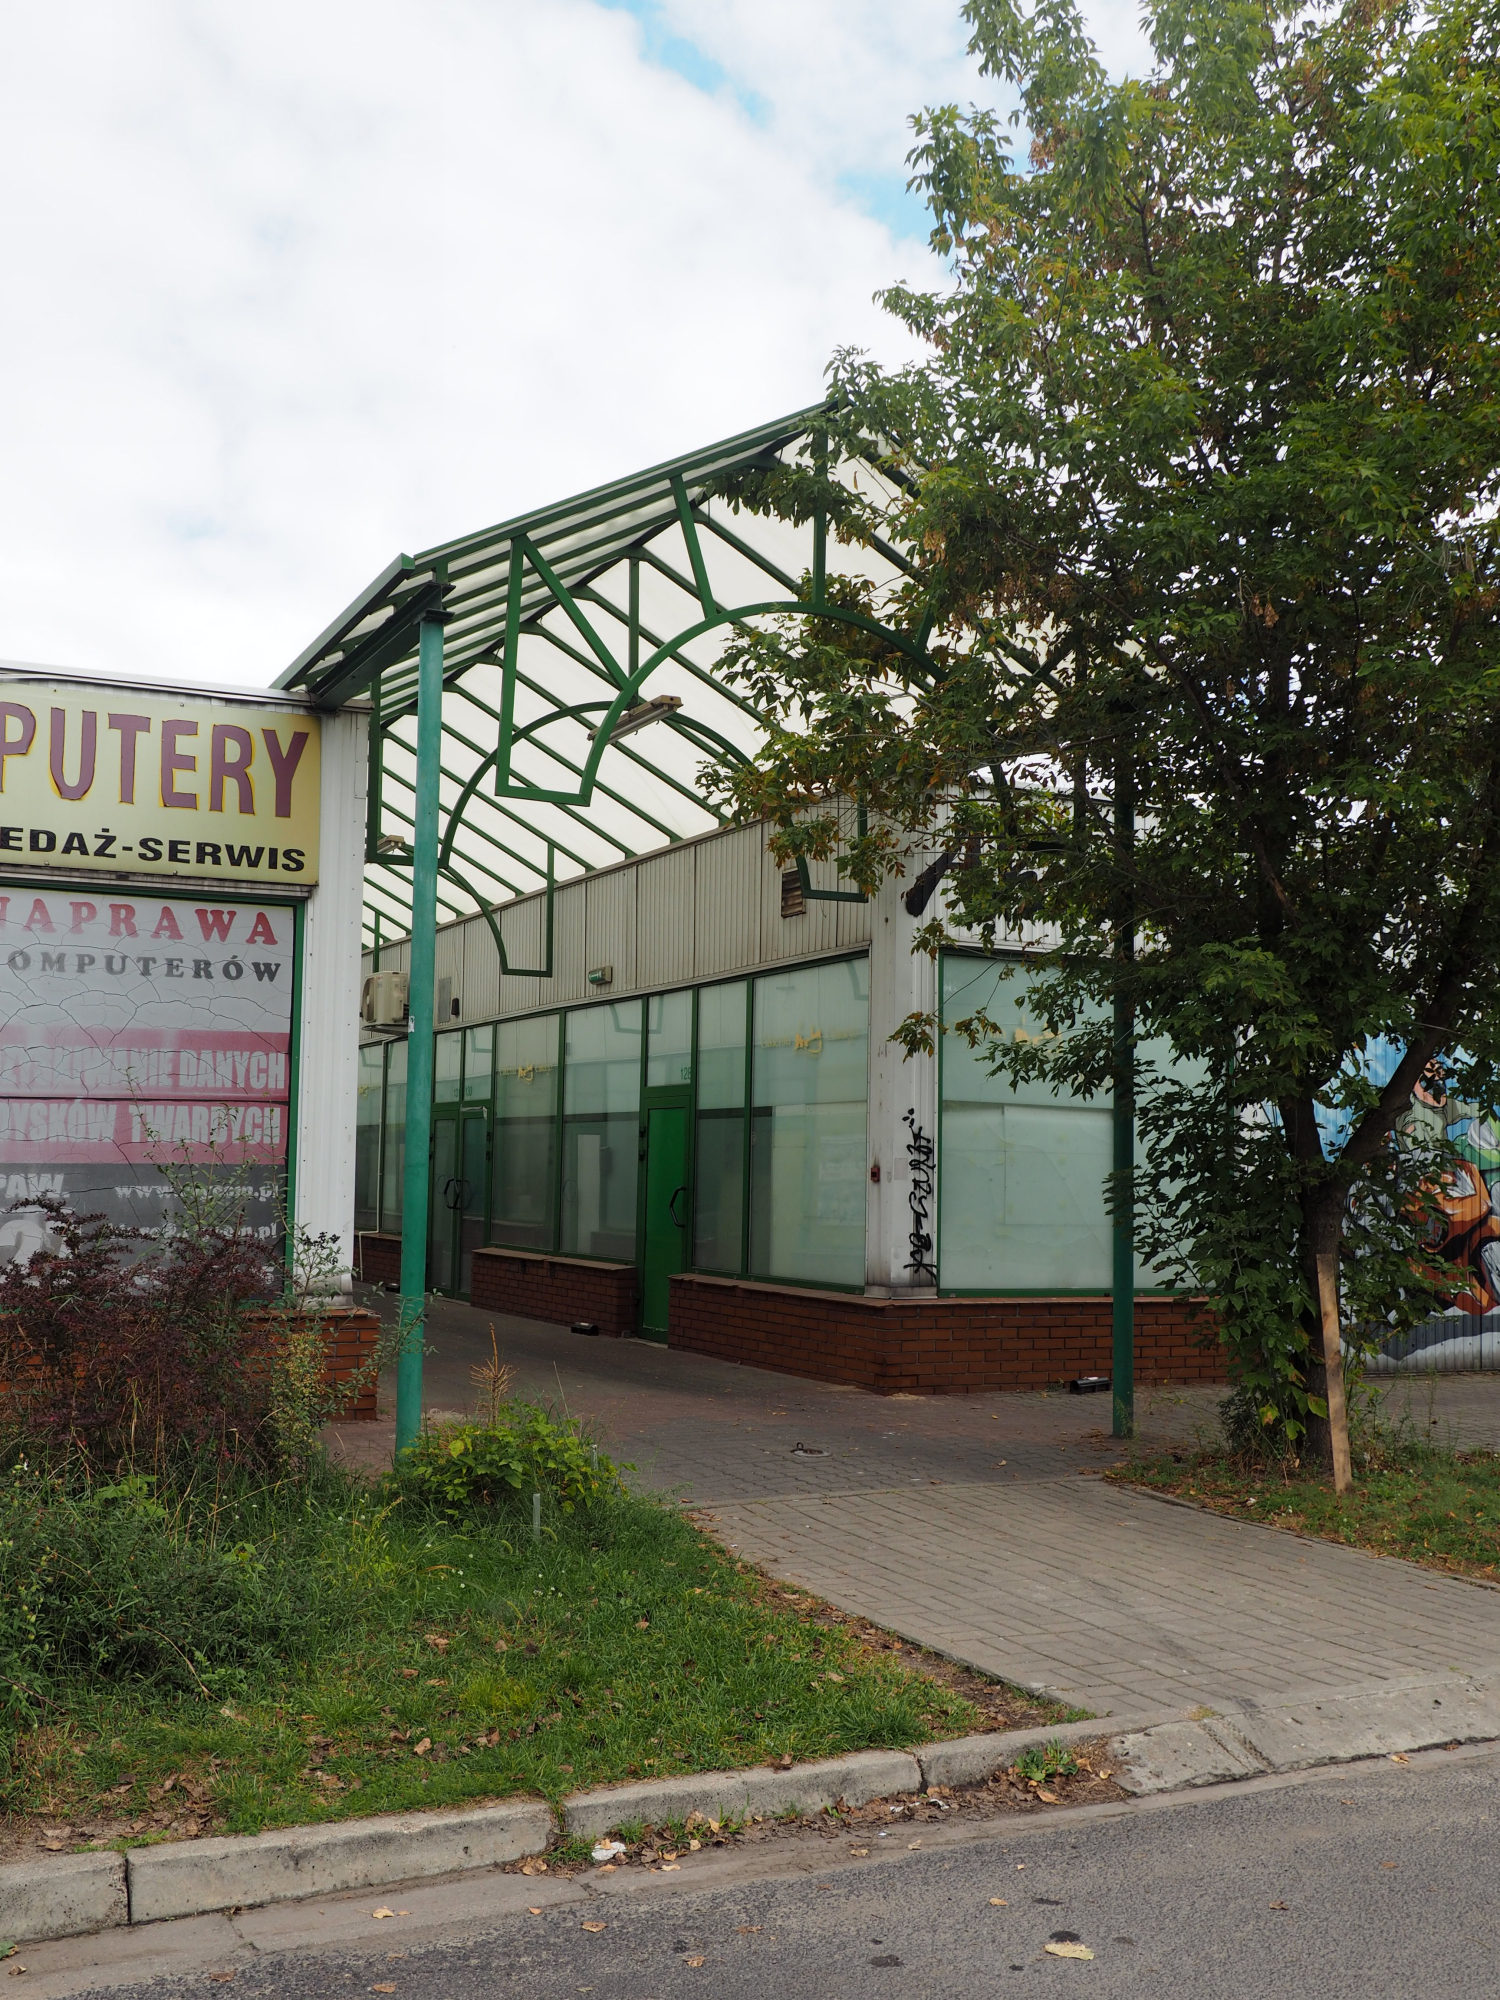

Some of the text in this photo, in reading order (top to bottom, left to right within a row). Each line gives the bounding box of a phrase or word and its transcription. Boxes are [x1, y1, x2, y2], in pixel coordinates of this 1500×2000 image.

[0, 702, 310, 818] PUTERY
[0, 827, 306, 872] EDAŻ-SERWIS
[8, 949, 282, 982] OMPUTERÓW
[179, 1050, 285, 1089] DANYCH
[128, 1104, 280, 1144] TWARDYCH
